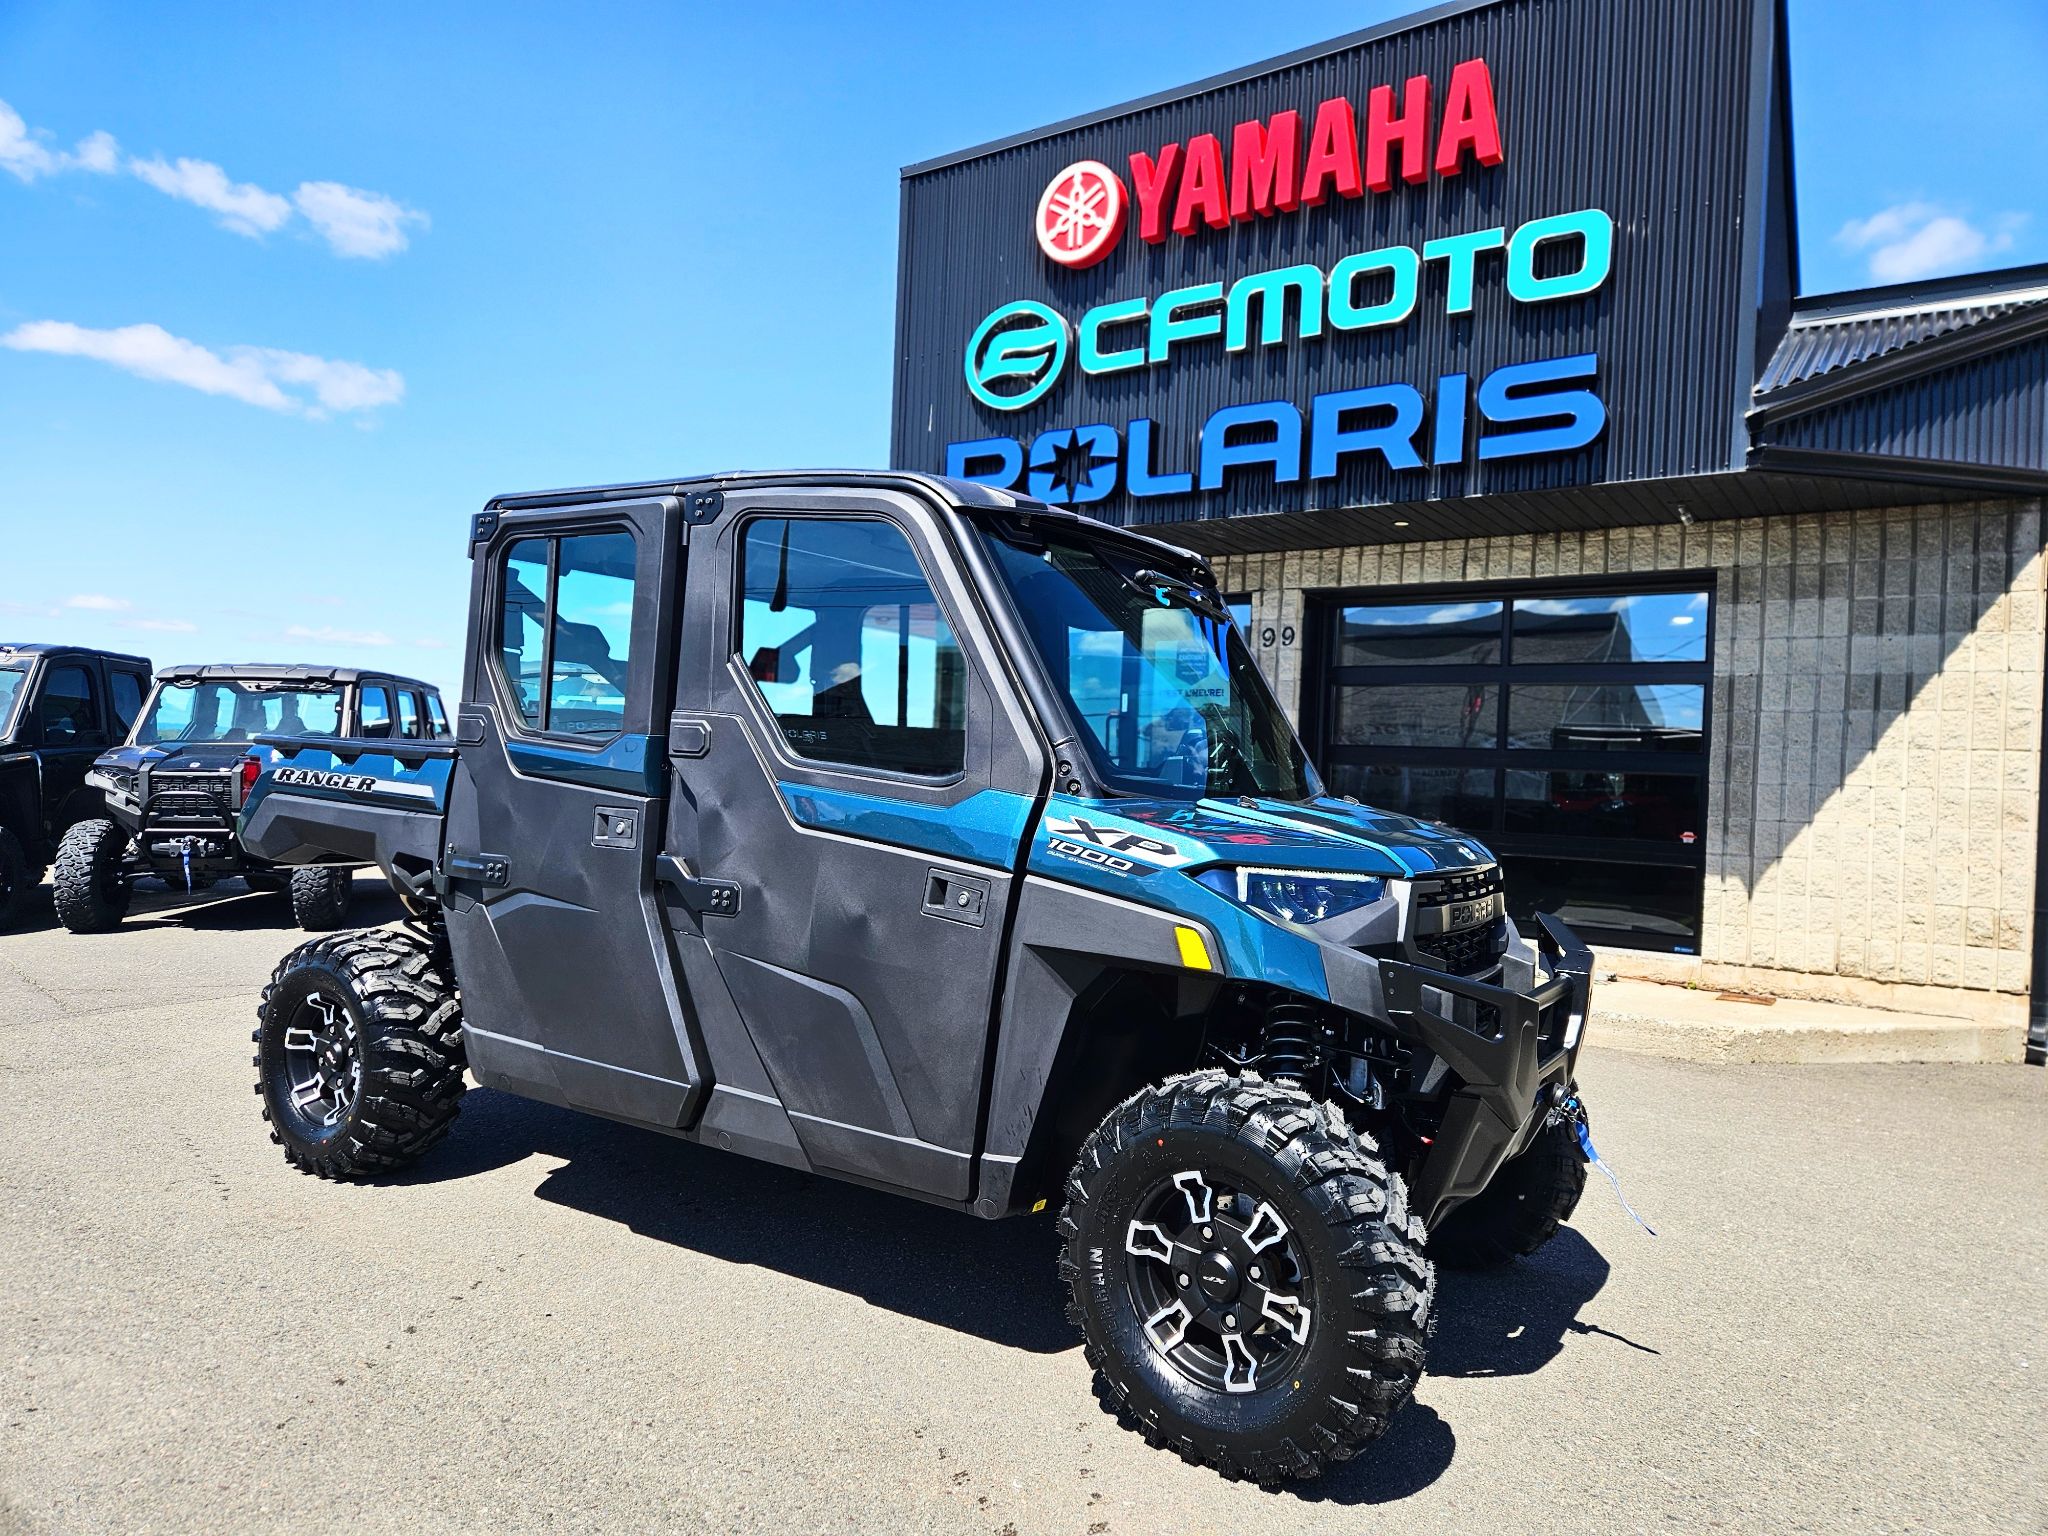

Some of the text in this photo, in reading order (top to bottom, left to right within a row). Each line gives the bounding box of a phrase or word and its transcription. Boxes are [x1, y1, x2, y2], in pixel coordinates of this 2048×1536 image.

[1129, 57, 1504, 245] YAMAHA
[1077, 208, 1614, 375] CFMOTO
[946, 352, 1607, 504] POLARIS
[1262, 626, 1295, 648] 99
[157, 783, 224, 793] POLARIS
[276, 767, 377, 792] RANGER
[1047, 837, 1134, 871] 1000
[1052, 817, 1177, 855] XP
